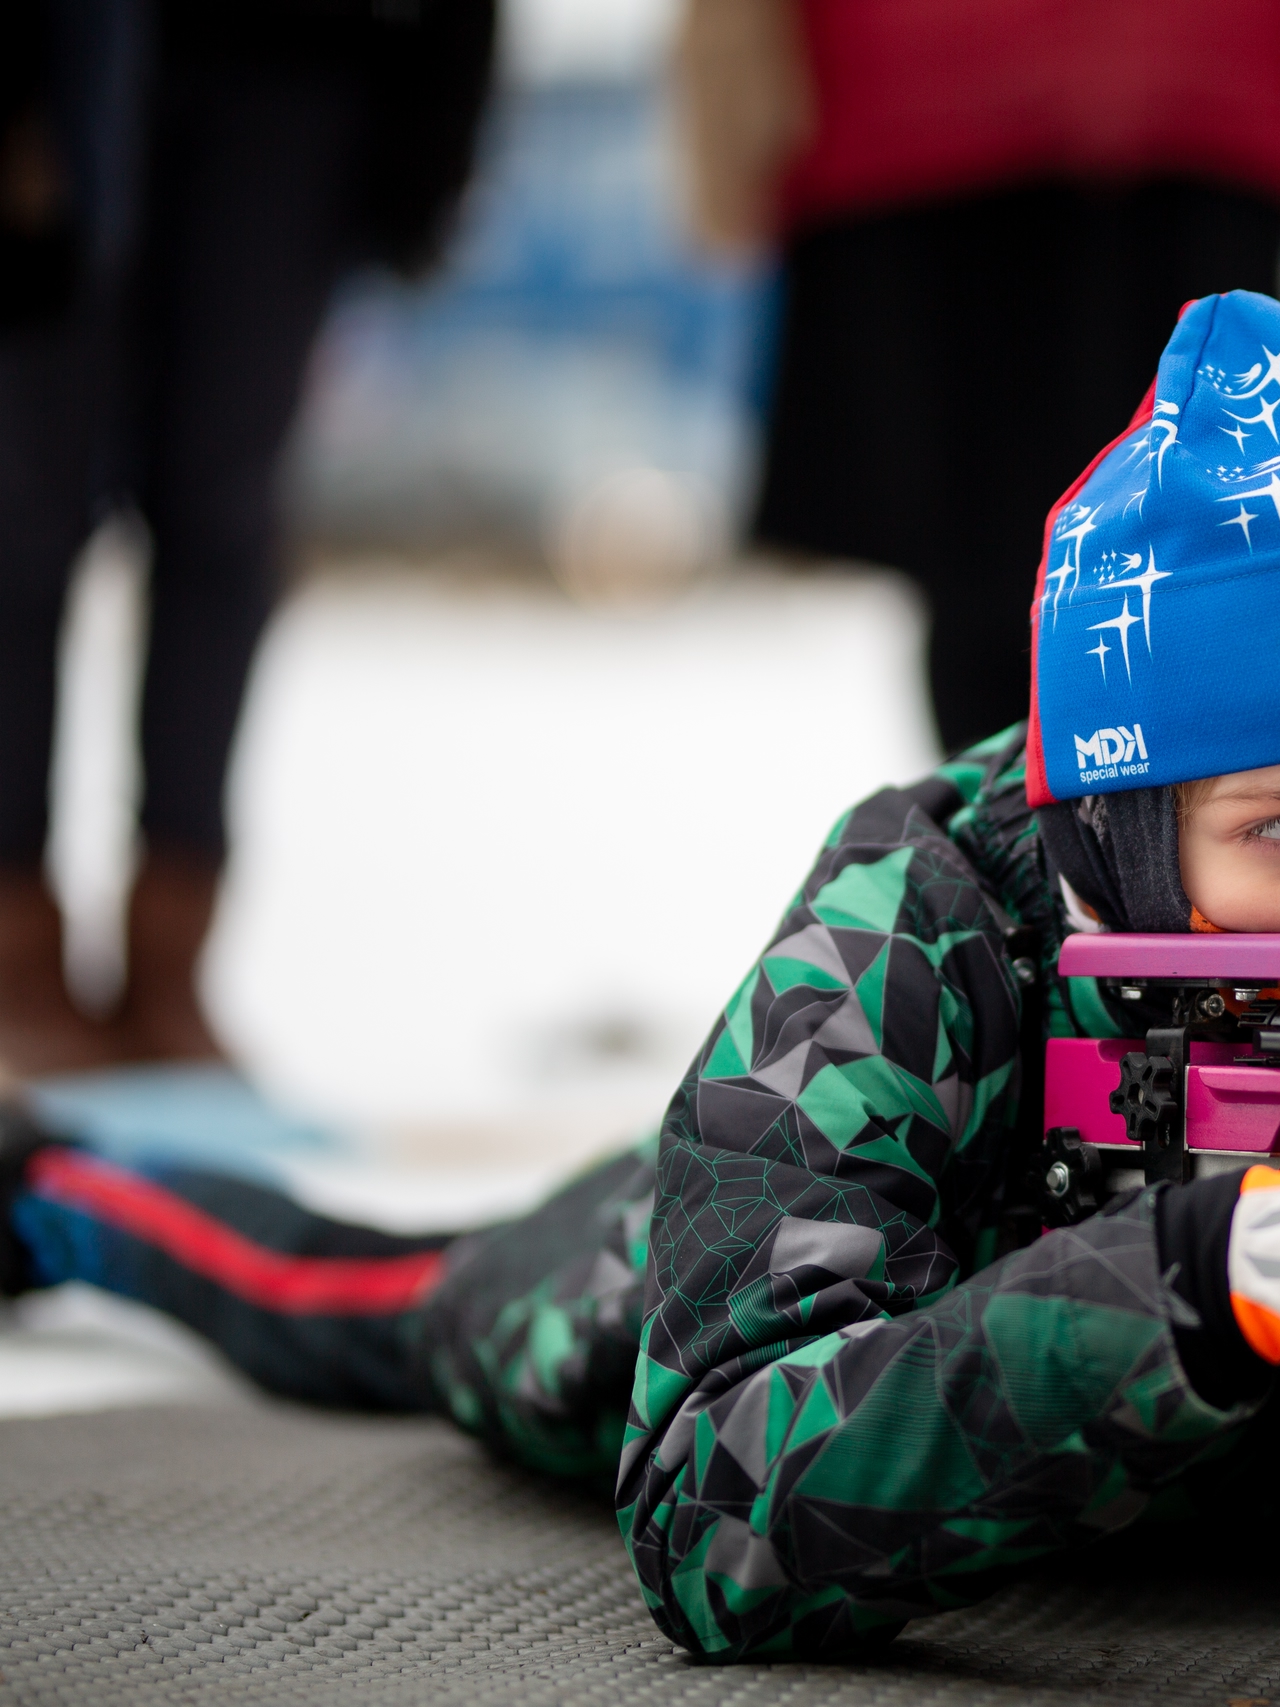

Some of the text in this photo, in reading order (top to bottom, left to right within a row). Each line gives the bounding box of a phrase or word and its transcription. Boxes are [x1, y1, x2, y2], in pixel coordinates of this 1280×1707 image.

[1074, 723, 1149, 769] MDK
[1080, 762, 1150, 785] special wear
